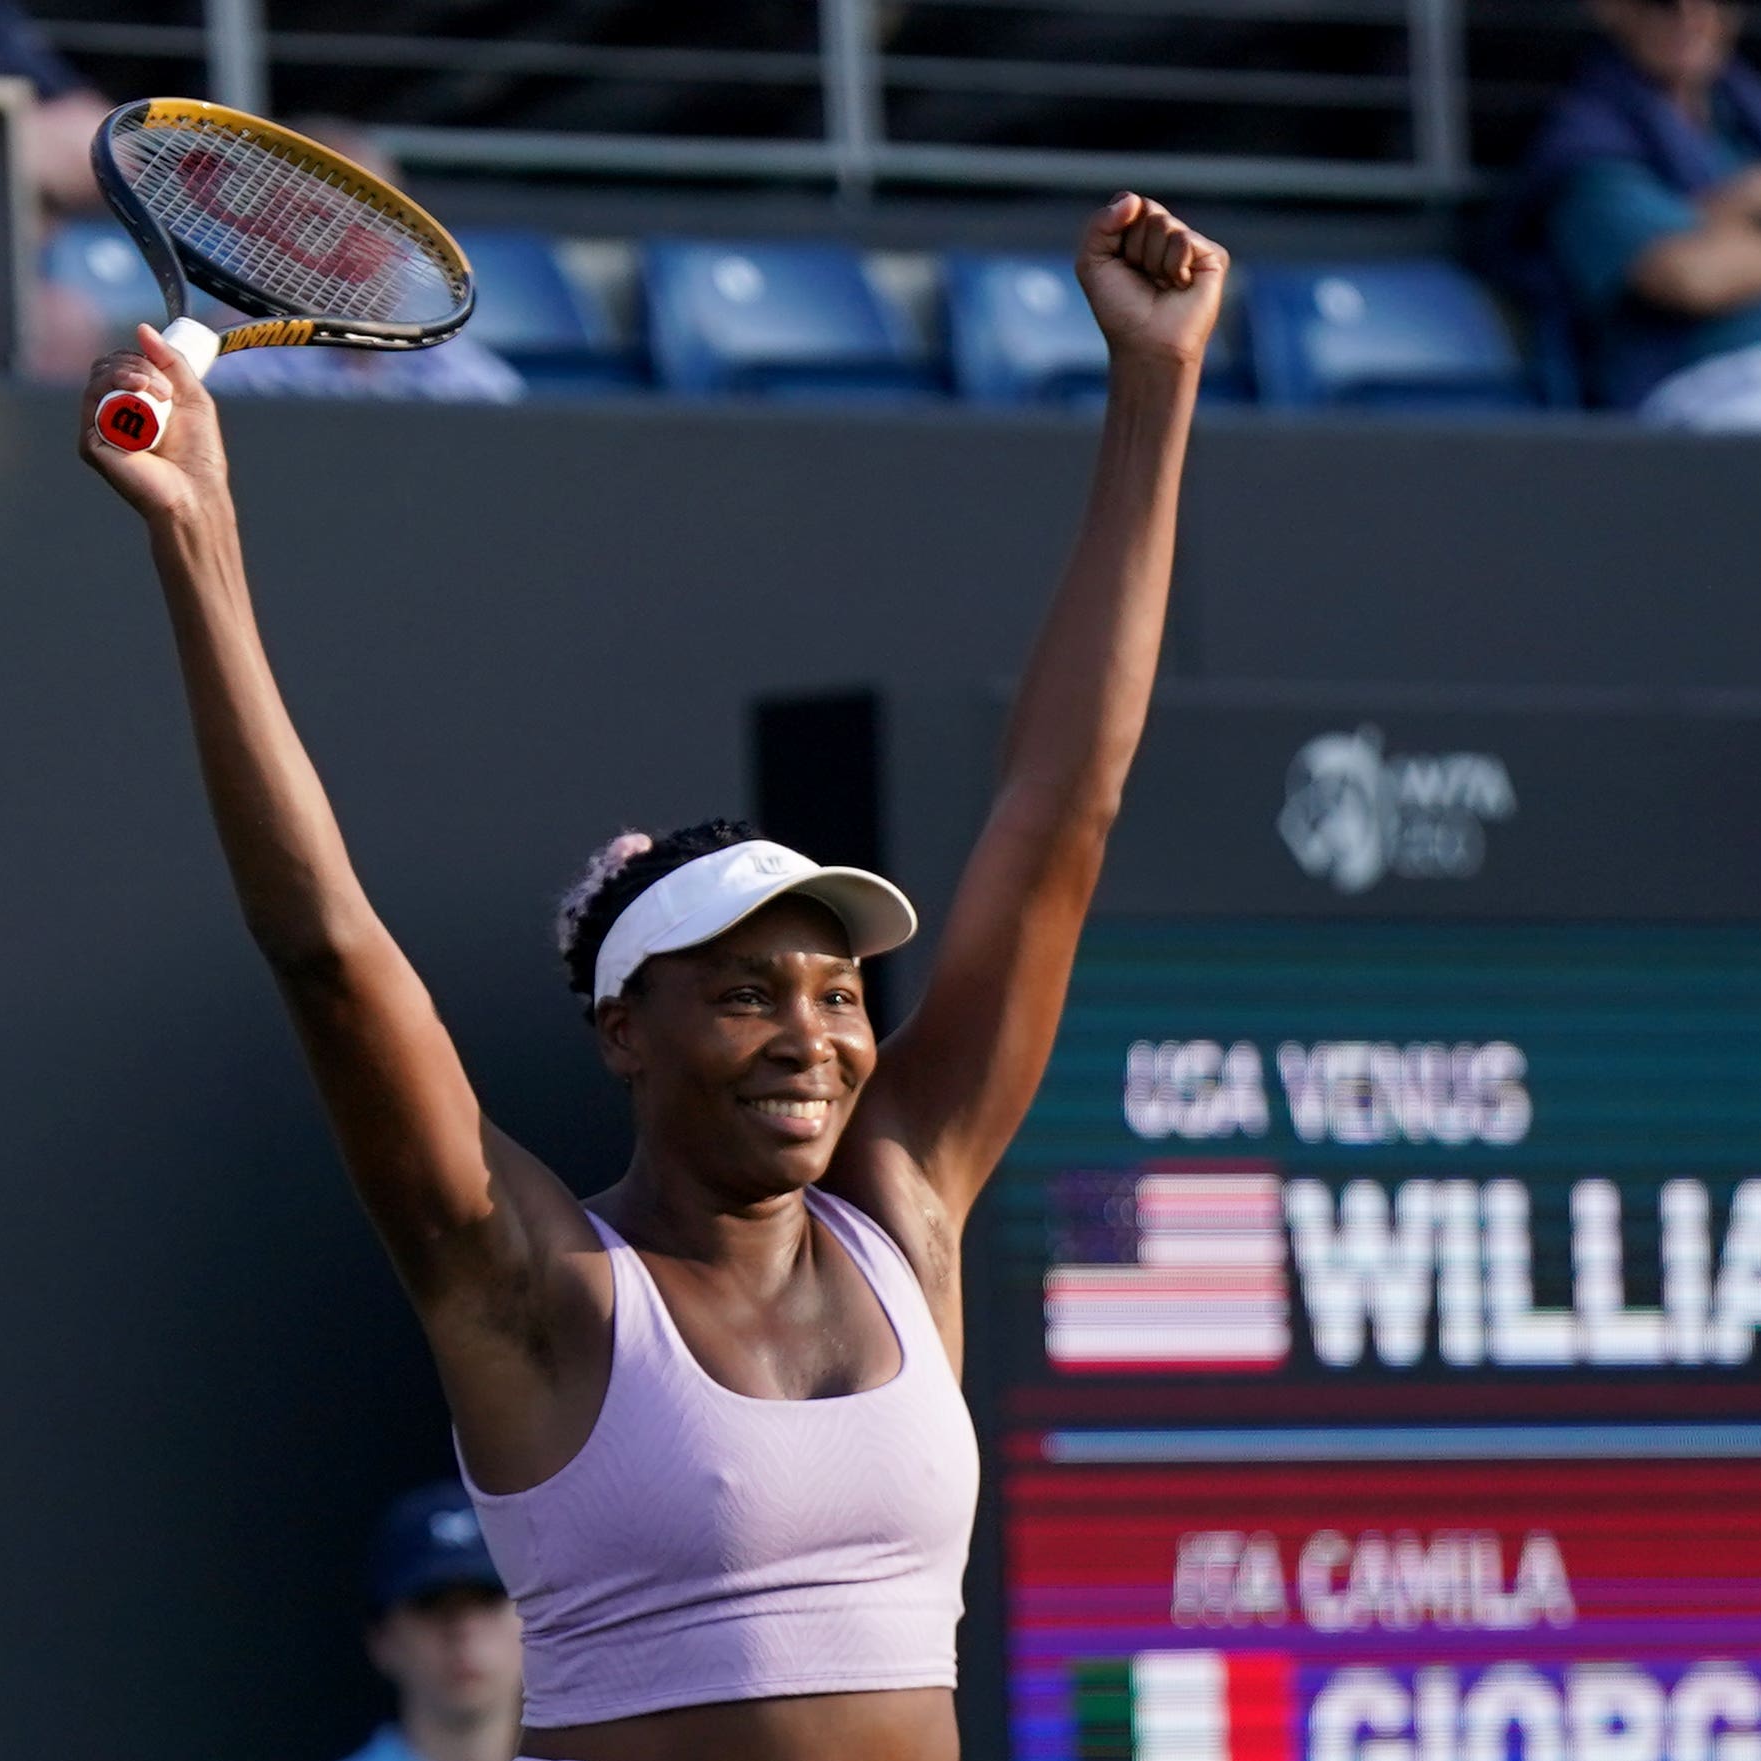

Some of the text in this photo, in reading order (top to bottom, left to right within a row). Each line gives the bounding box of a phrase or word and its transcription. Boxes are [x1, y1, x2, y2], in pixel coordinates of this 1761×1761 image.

[1126, 1040, 1533, 1145] USA VENUS
[1170, 1528, 1576, 1633] ITA CAMILA
